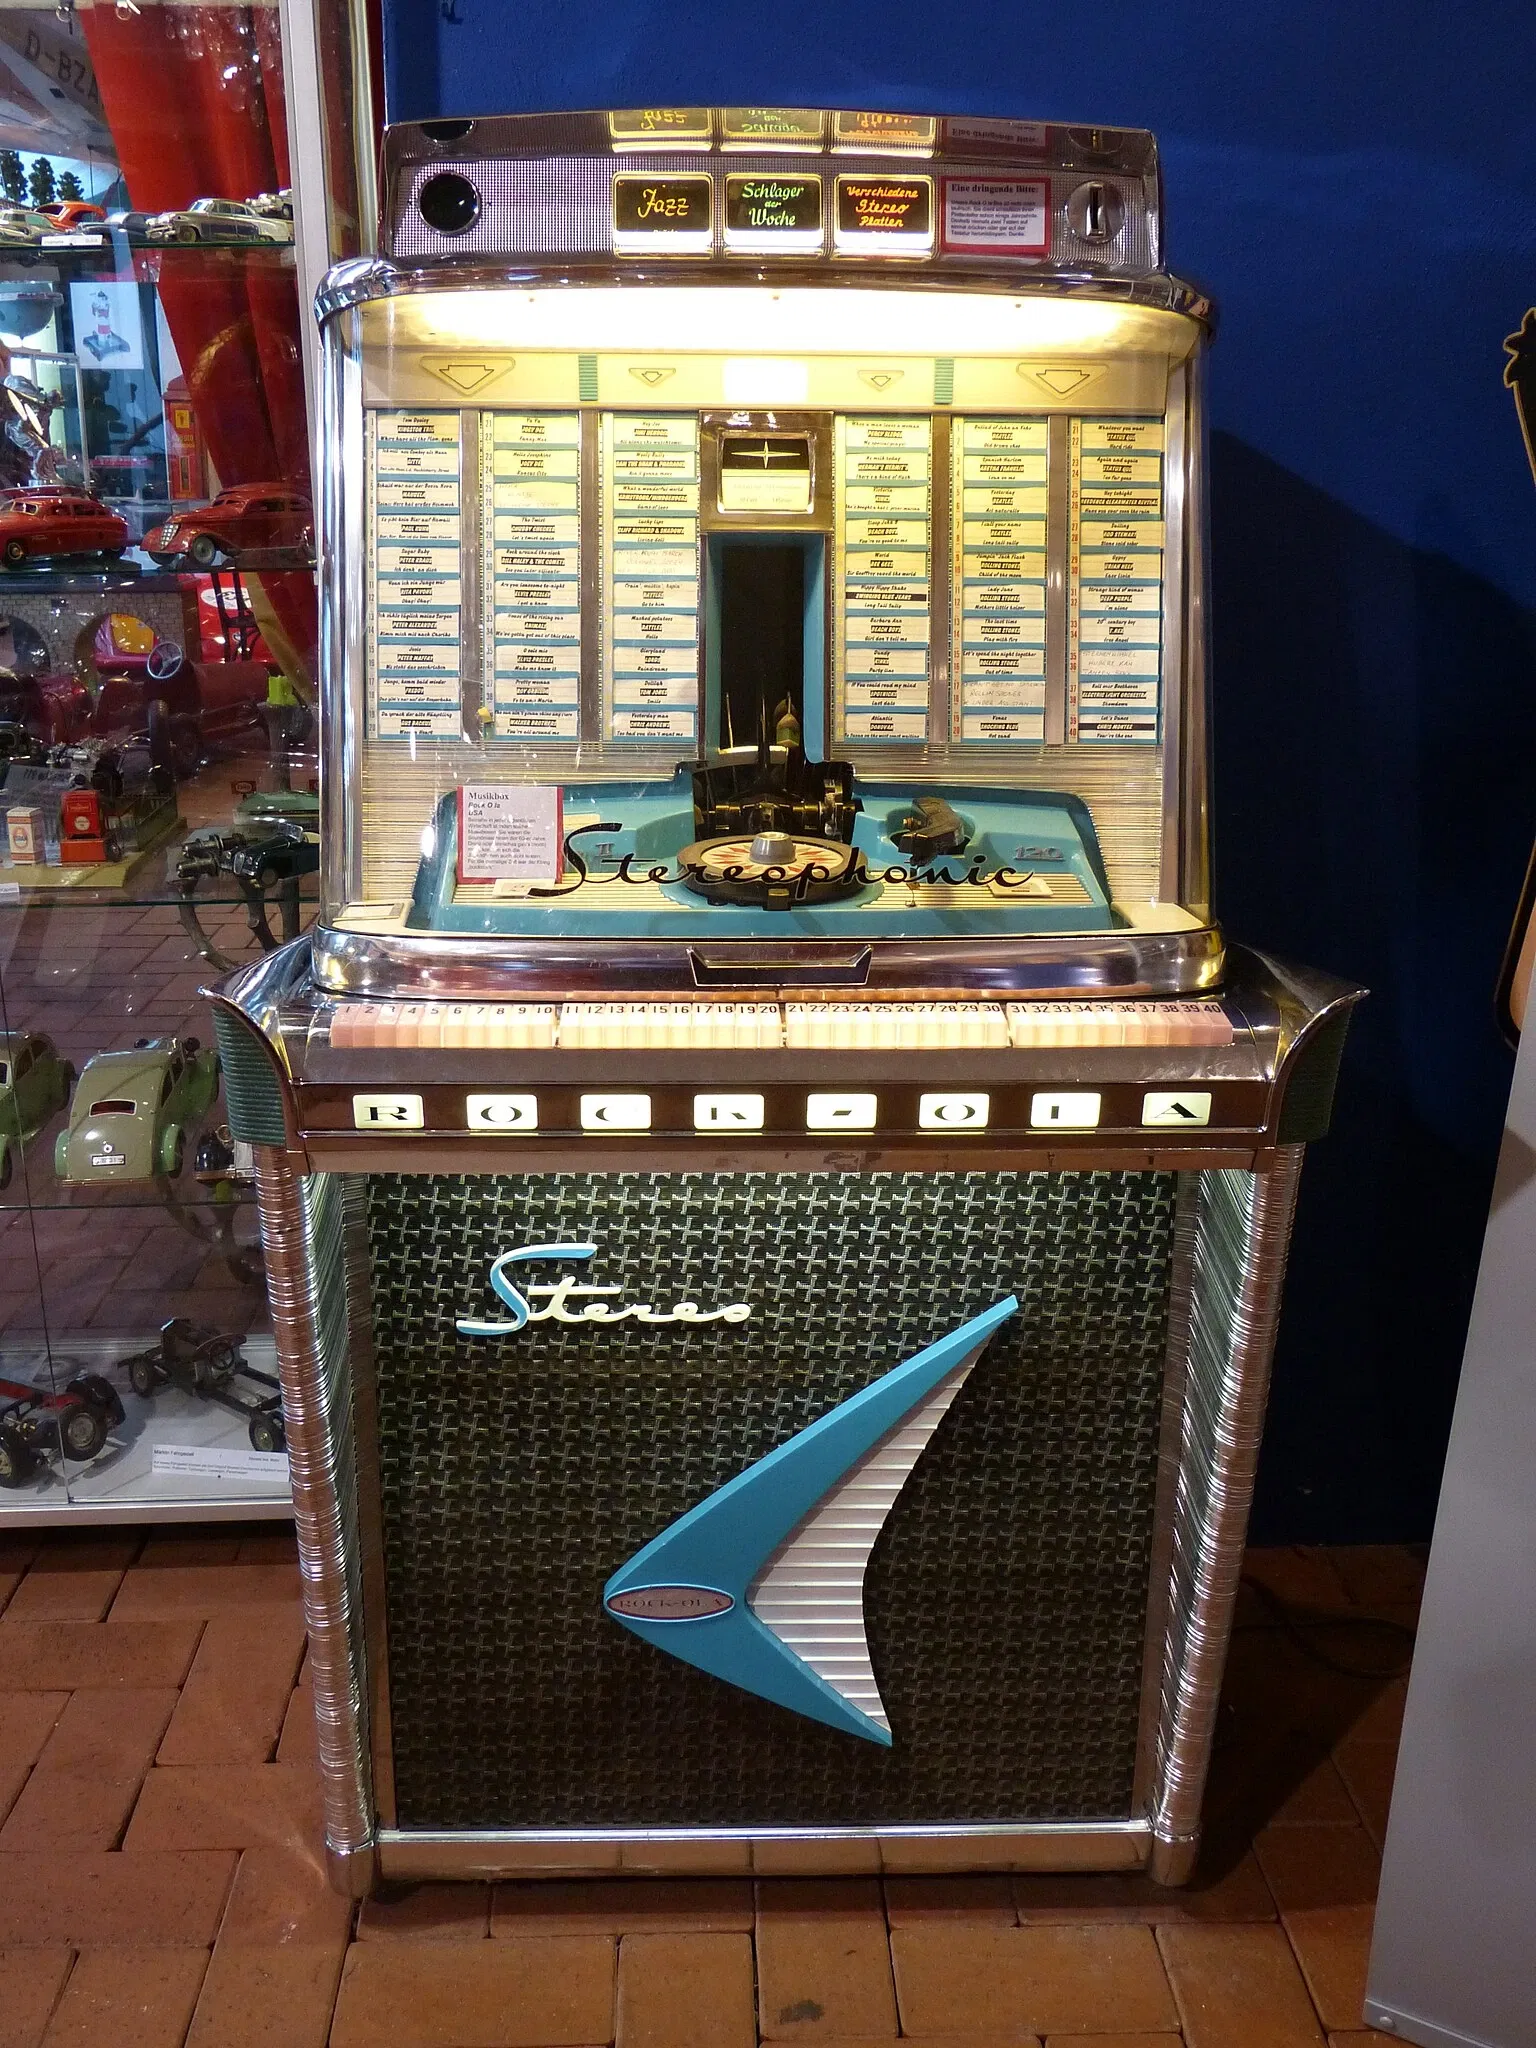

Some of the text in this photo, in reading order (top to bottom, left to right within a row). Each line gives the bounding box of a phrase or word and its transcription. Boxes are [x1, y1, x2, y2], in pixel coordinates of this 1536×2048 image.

[742, 182, 804, 200] Schlager
[847, 187, 918, 198] Verschiedene
[952, 184, 969, 192] Eine
[972, 184, 1013, 194] dringende
[638, 188, 689, 218] Jazz
[856, 200, 910, 214] Stereo
[749, 208, 796, 226] Woche
[469, 792, 509, 800] Musikbox
[528, 822, 1035, 898] Stereophonic
[1010, 1005, 1026, 1013] 31
[1032, 1005, 1049, 1013] 32
[1140, 1005, 1156, 1013] 37
[1160, 1005, 1179, 1013] 38
[1182, 1004, 1200, 1012] 39
[1204, 1004, 1221, 1013] 40
[455, 1242, 751, 1335] Stereo
